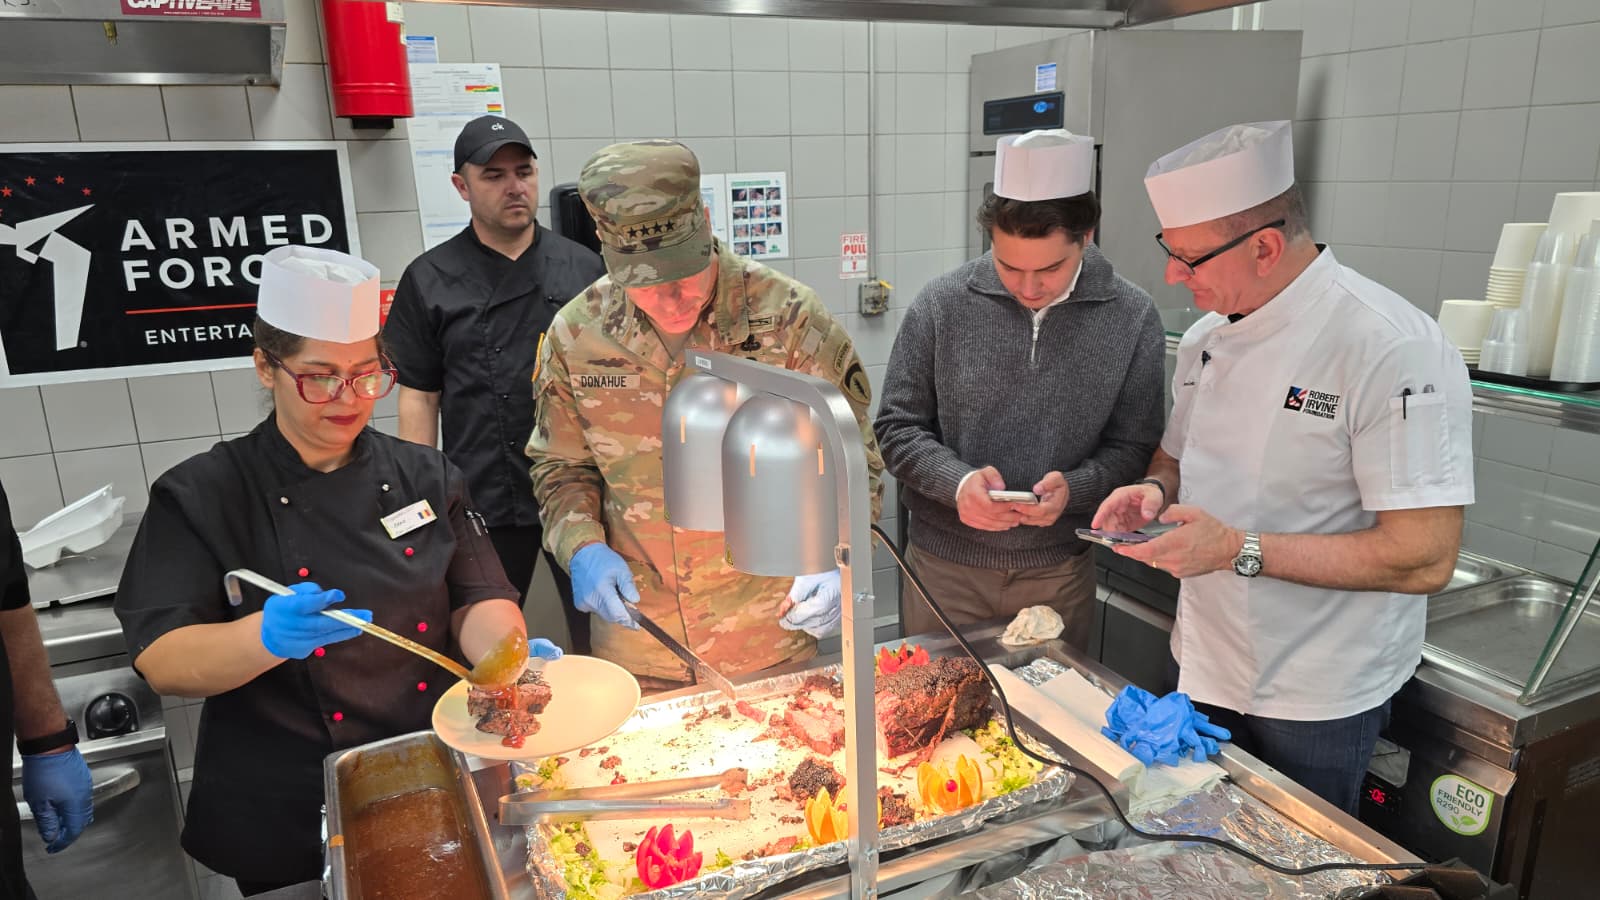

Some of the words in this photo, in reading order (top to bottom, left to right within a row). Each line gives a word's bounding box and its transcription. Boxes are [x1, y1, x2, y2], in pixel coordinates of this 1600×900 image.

[491, 122, 505, 131] ck
[121, 213, 333, 251] ARMED
[843, 235, 865, 243] FIRE
[843, 244, 866, 255] PULL
[122, 254, 265, 291] FORC
[145, 323, 253, 345] ENTERTA
[581, 375, 627, 388] DONAHUE
[1309, 390, 1340, 403] ROBERT
[1305, 399, 1338, 414] IRVINE
[1438, 789, 1483, 817] FRIENDLY
[1456, 784, 1485, 808] ECO
[1436, 797, 1460, 815] R290
